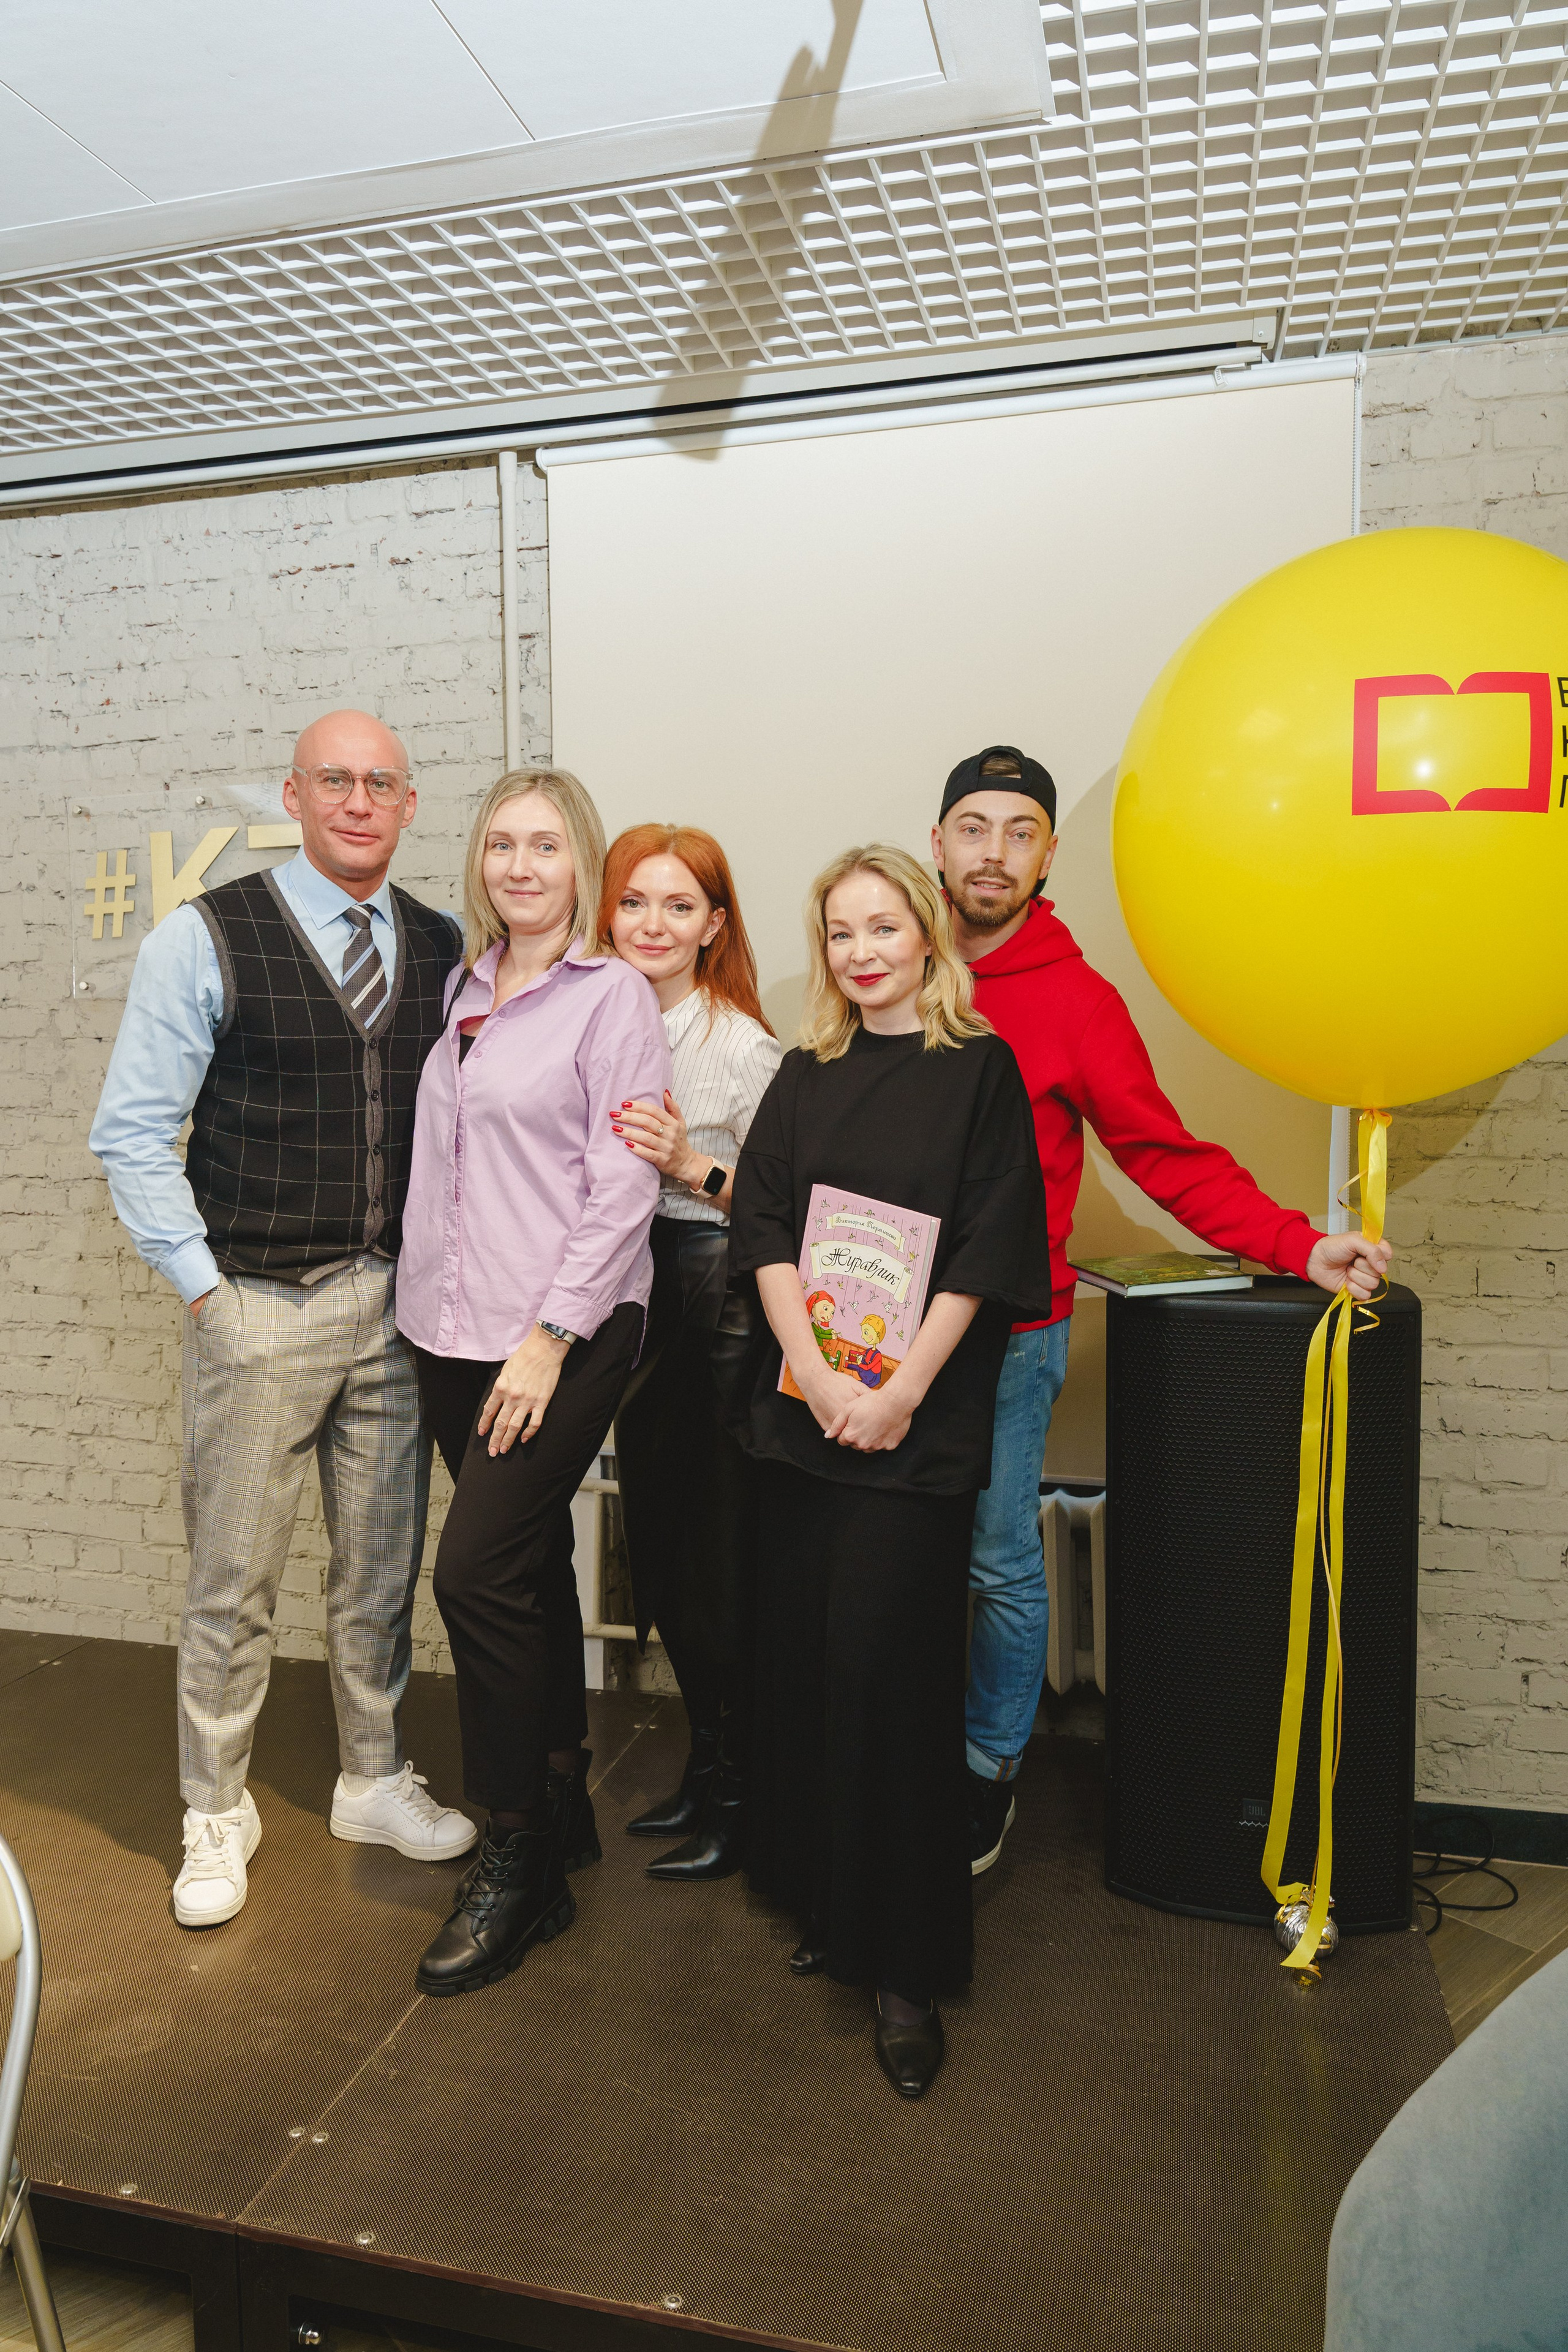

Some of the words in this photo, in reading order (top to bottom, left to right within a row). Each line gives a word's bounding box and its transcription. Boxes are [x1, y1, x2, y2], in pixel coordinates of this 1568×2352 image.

[835, 1216, 865, 1227] Виктория
[866, 1221, 897, 1241] Перминова
[821, 1248, 900, 1286] Журавлик
[1249, 1805, 1266, 1816] JBL
